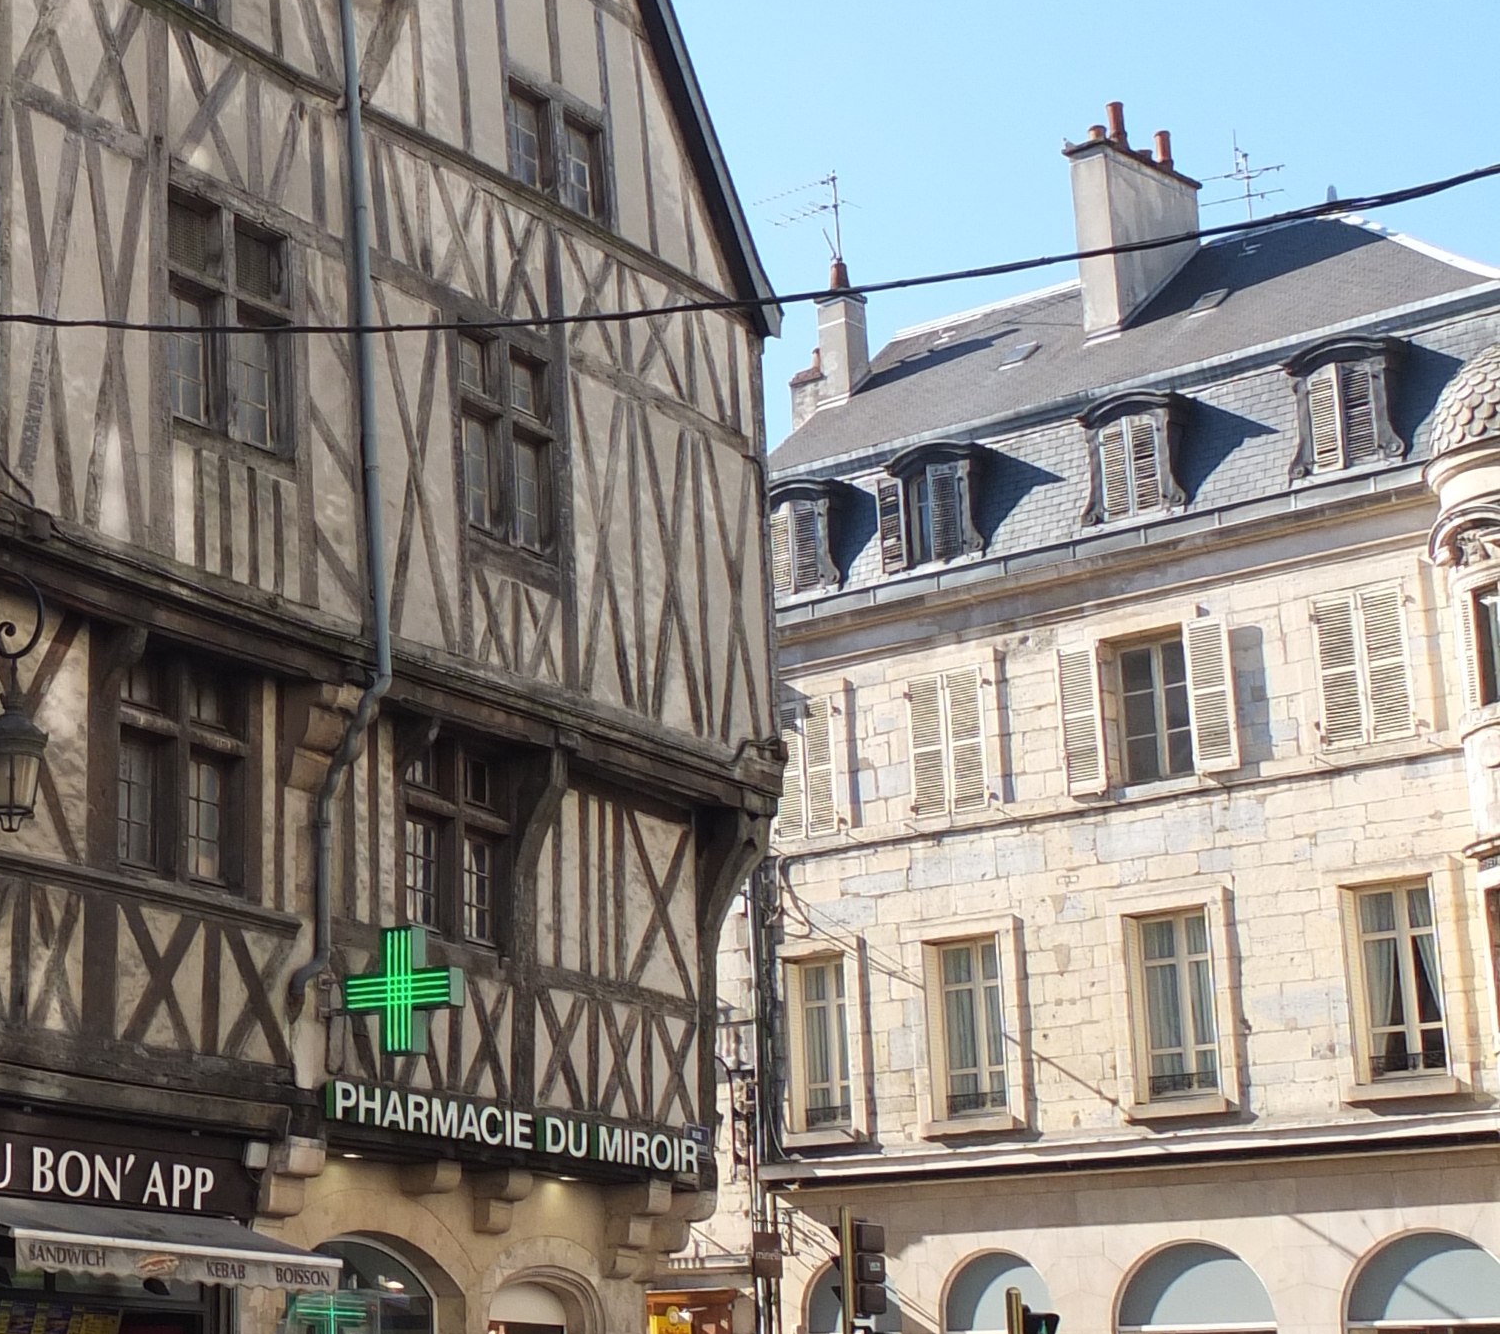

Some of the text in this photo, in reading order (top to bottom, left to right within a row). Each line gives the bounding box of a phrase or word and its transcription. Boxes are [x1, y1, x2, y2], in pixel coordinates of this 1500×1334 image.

[334, 1080, 534, 1150] PHARMACIE
[545, 1117, 588, 1158] DU
[598, 1125, 698, 1174] MIROIR
[32, 1146, 136, 1201] BON'
[142, 1161, 214, 1210] APP
[28, 1243, 330, 1286] SANDWICH KEBAB BOISSON
